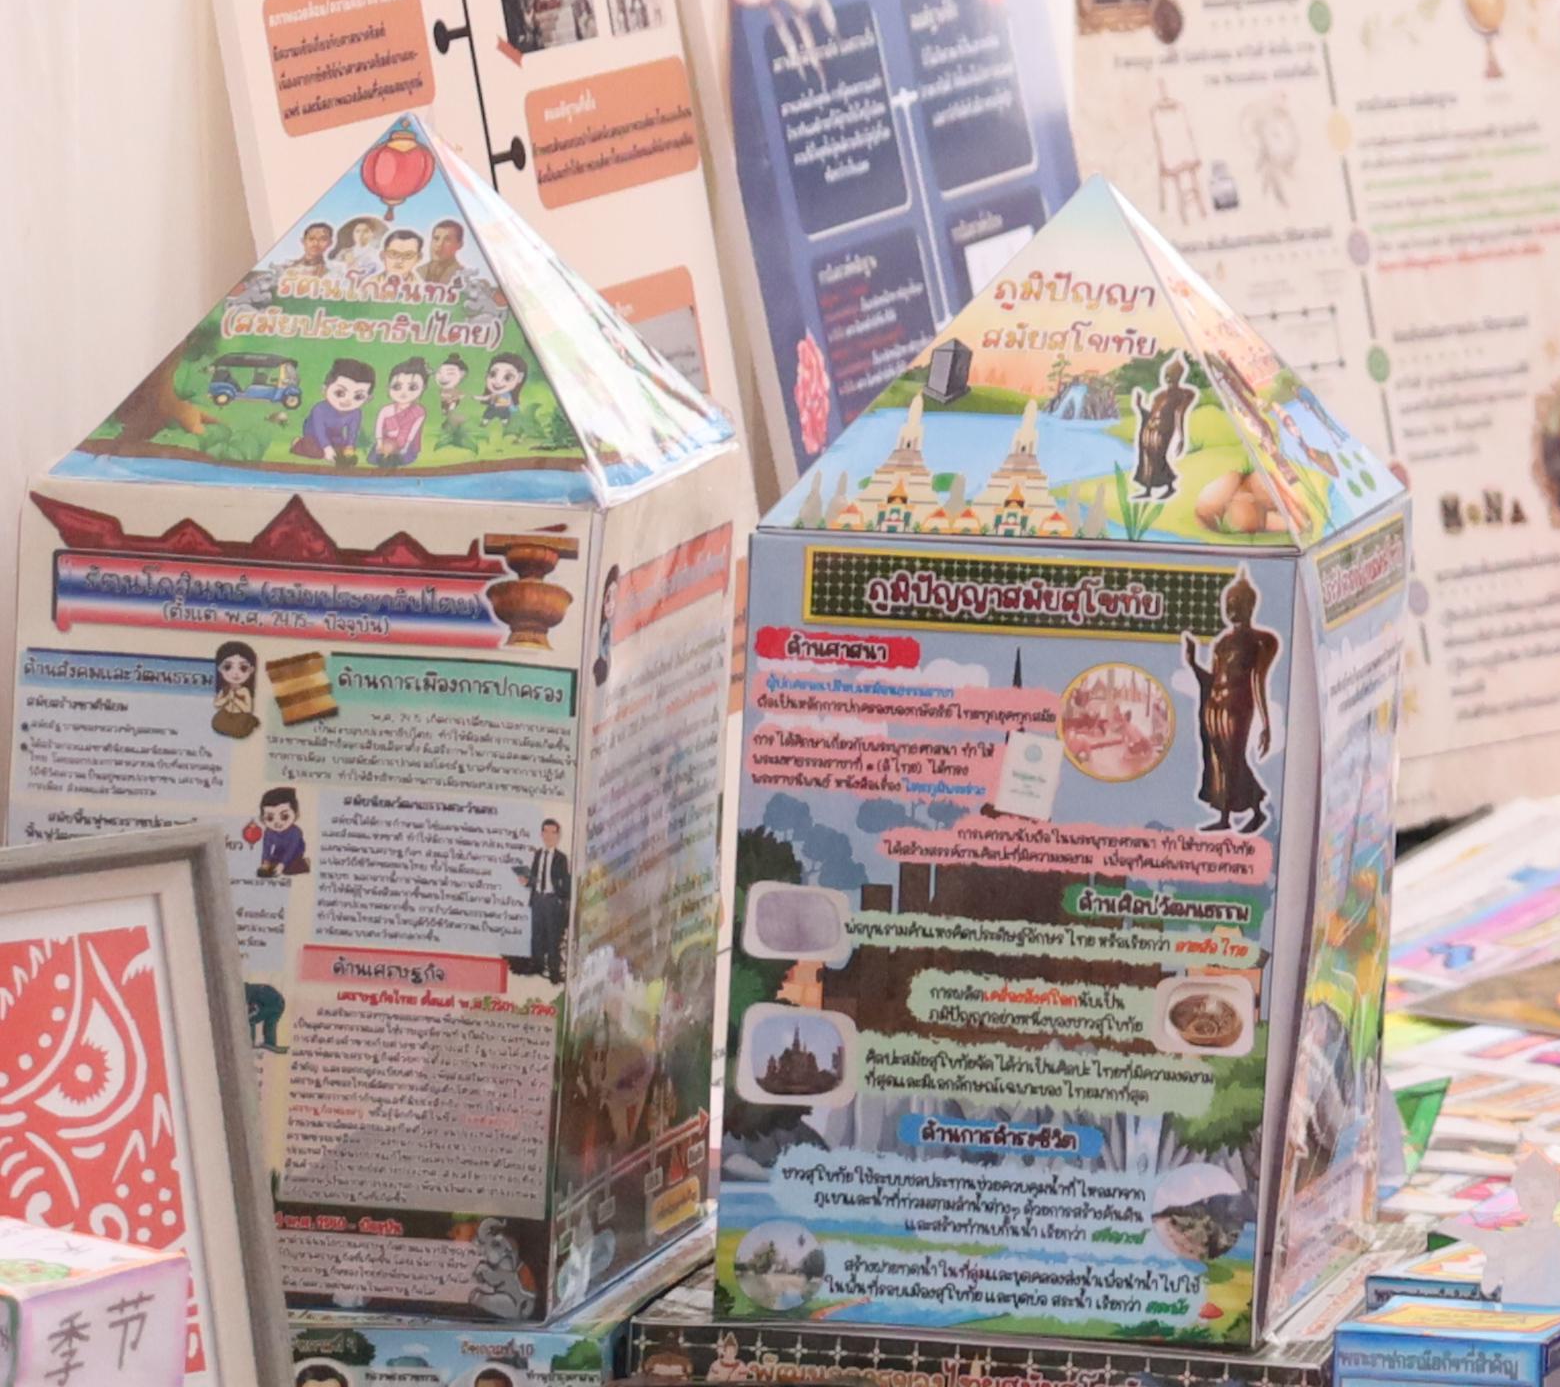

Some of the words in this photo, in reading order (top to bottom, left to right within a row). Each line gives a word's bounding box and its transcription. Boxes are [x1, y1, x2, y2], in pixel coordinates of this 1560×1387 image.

[277, 268, 465, 306] รัตนโกสินทร์
[993, 269, 1156, 311] ภูมิปัญญา
[220, 306, 503, 350] (สมัยประชาธิปไตย)
[980, 322, 1158, 360] สมัยสุโขทัย
[869, 570, 1166, 624] ภูมิปัญญาสมัยสุโขทัย
[787, 635, 888, 661] ด้านศาสนา
[338, 666, 564, 703] ด้านการเมืองการปกครอง
[44, 1291, 156, 1386] 季节
